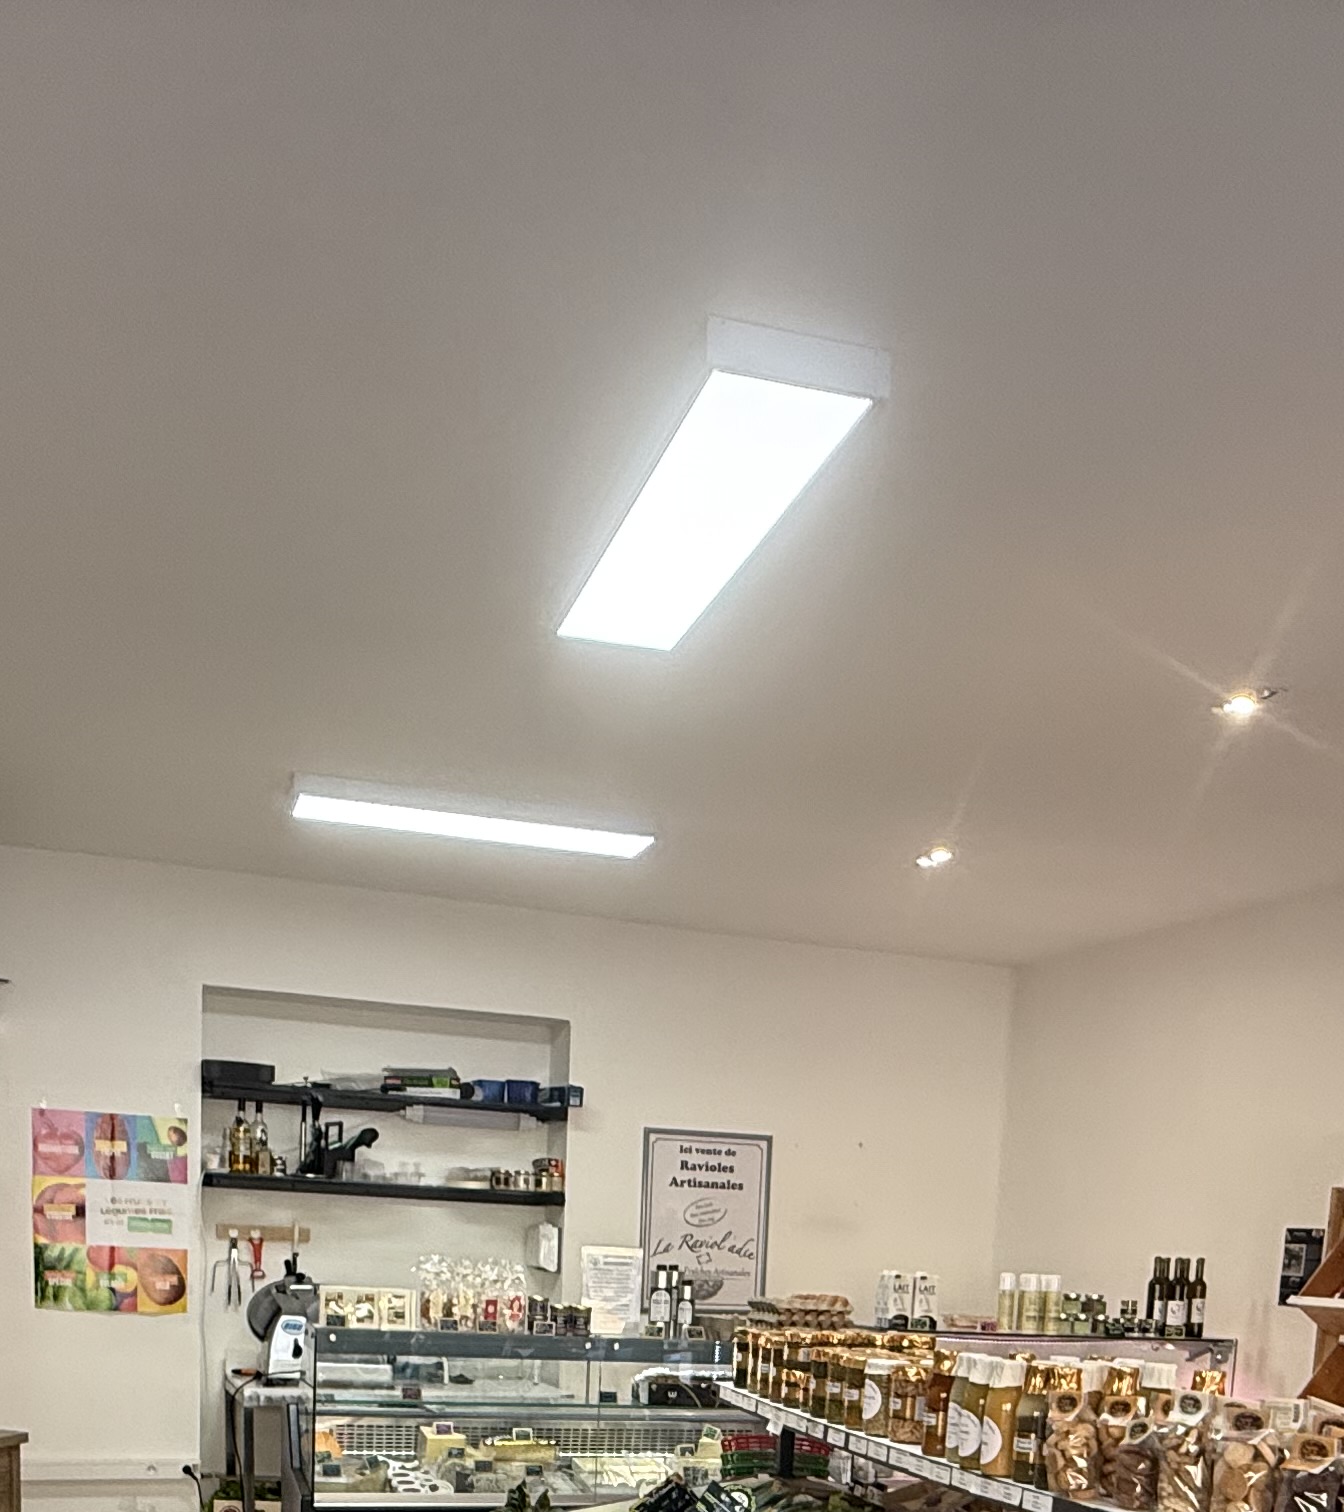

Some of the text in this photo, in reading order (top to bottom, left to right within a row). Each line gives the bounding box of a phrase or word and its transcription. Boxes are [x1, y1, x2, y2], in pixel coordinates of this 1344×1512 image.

[679, 1144, 737, 1157] Ici vente de
[679, 1159, 735, 1174] Ravioles
[668, 1176, 744, 1191] Artisanales
[893, 1283, 910, 1292] LAIT
[918, 1284, 936, 1293] LAIT
